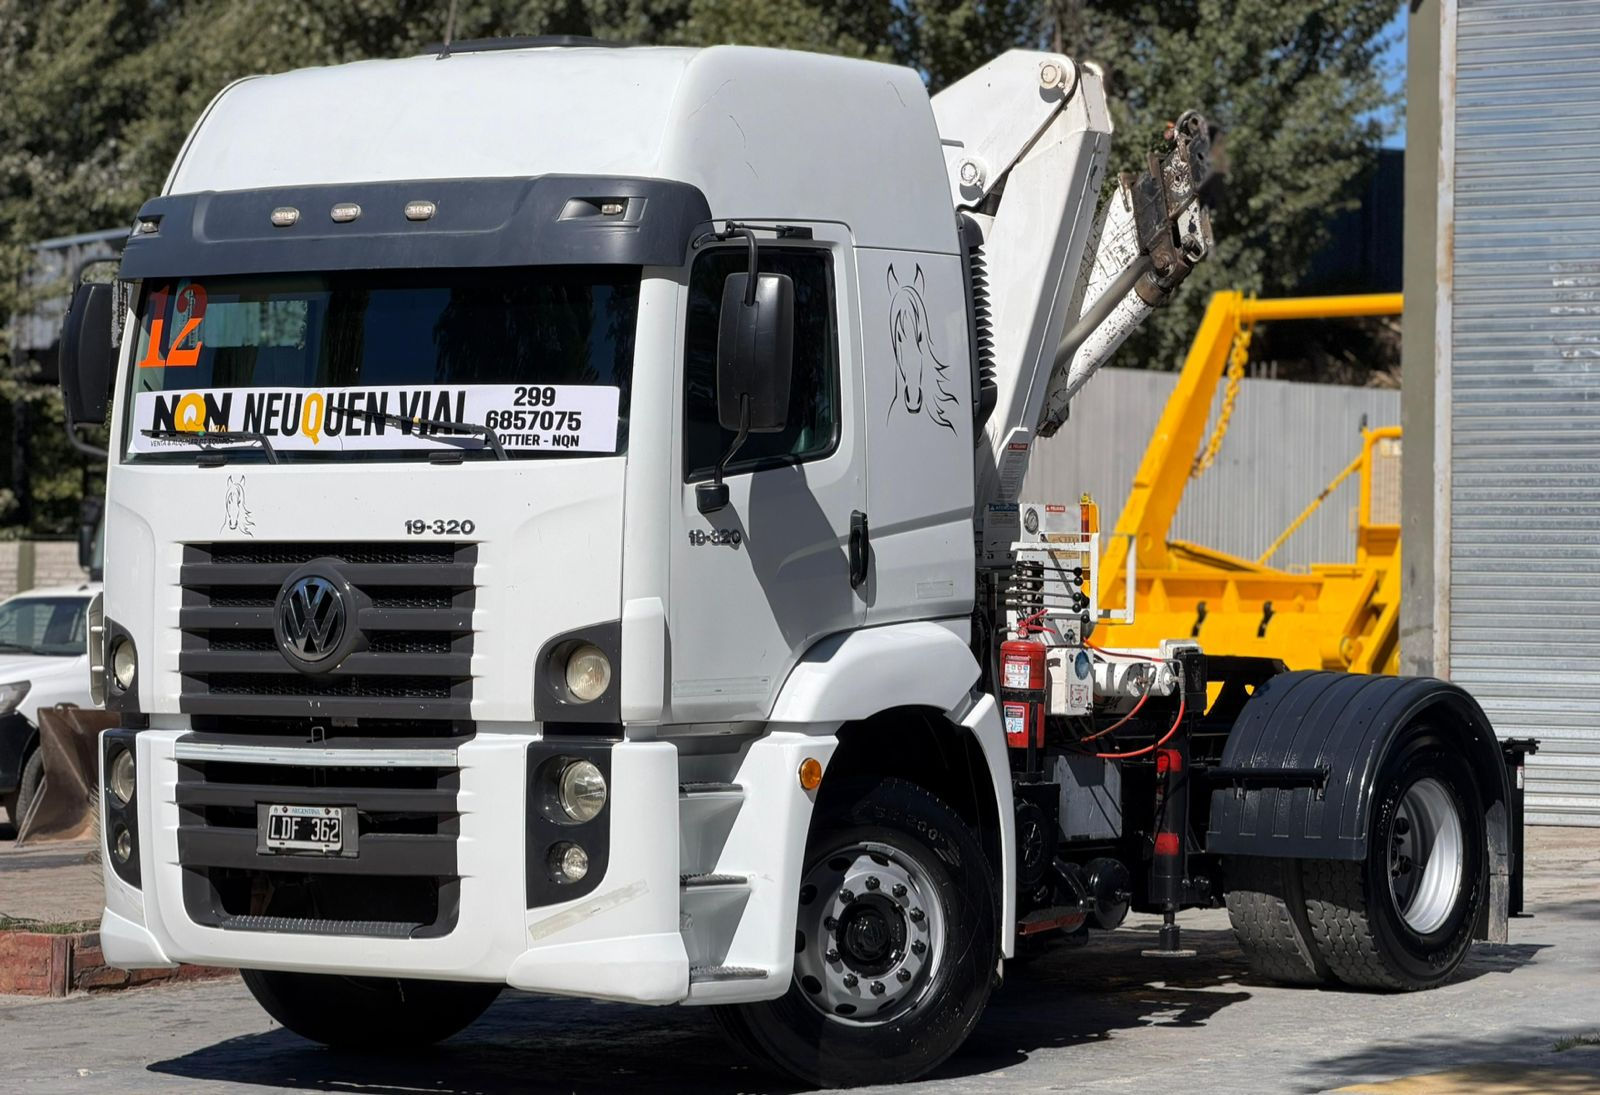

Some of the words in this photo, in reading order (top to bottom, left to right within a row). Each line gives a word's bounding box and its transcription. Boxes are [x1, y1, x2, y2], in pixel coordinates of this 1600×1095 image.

[138, 284, 208, 368] 12
[513, 387, 556, 407] 299
[152, 392, 232, 437] NQN
[243, 392, 389, 445] NEUQUEN
[485, 410, 582, 431] 6857075
[552, 435, 580, 448] NQN
[405, 519, 476, 535] 19-320
[270, 816, 301, 840] LDF
[311, 818, 339, 842] 362
